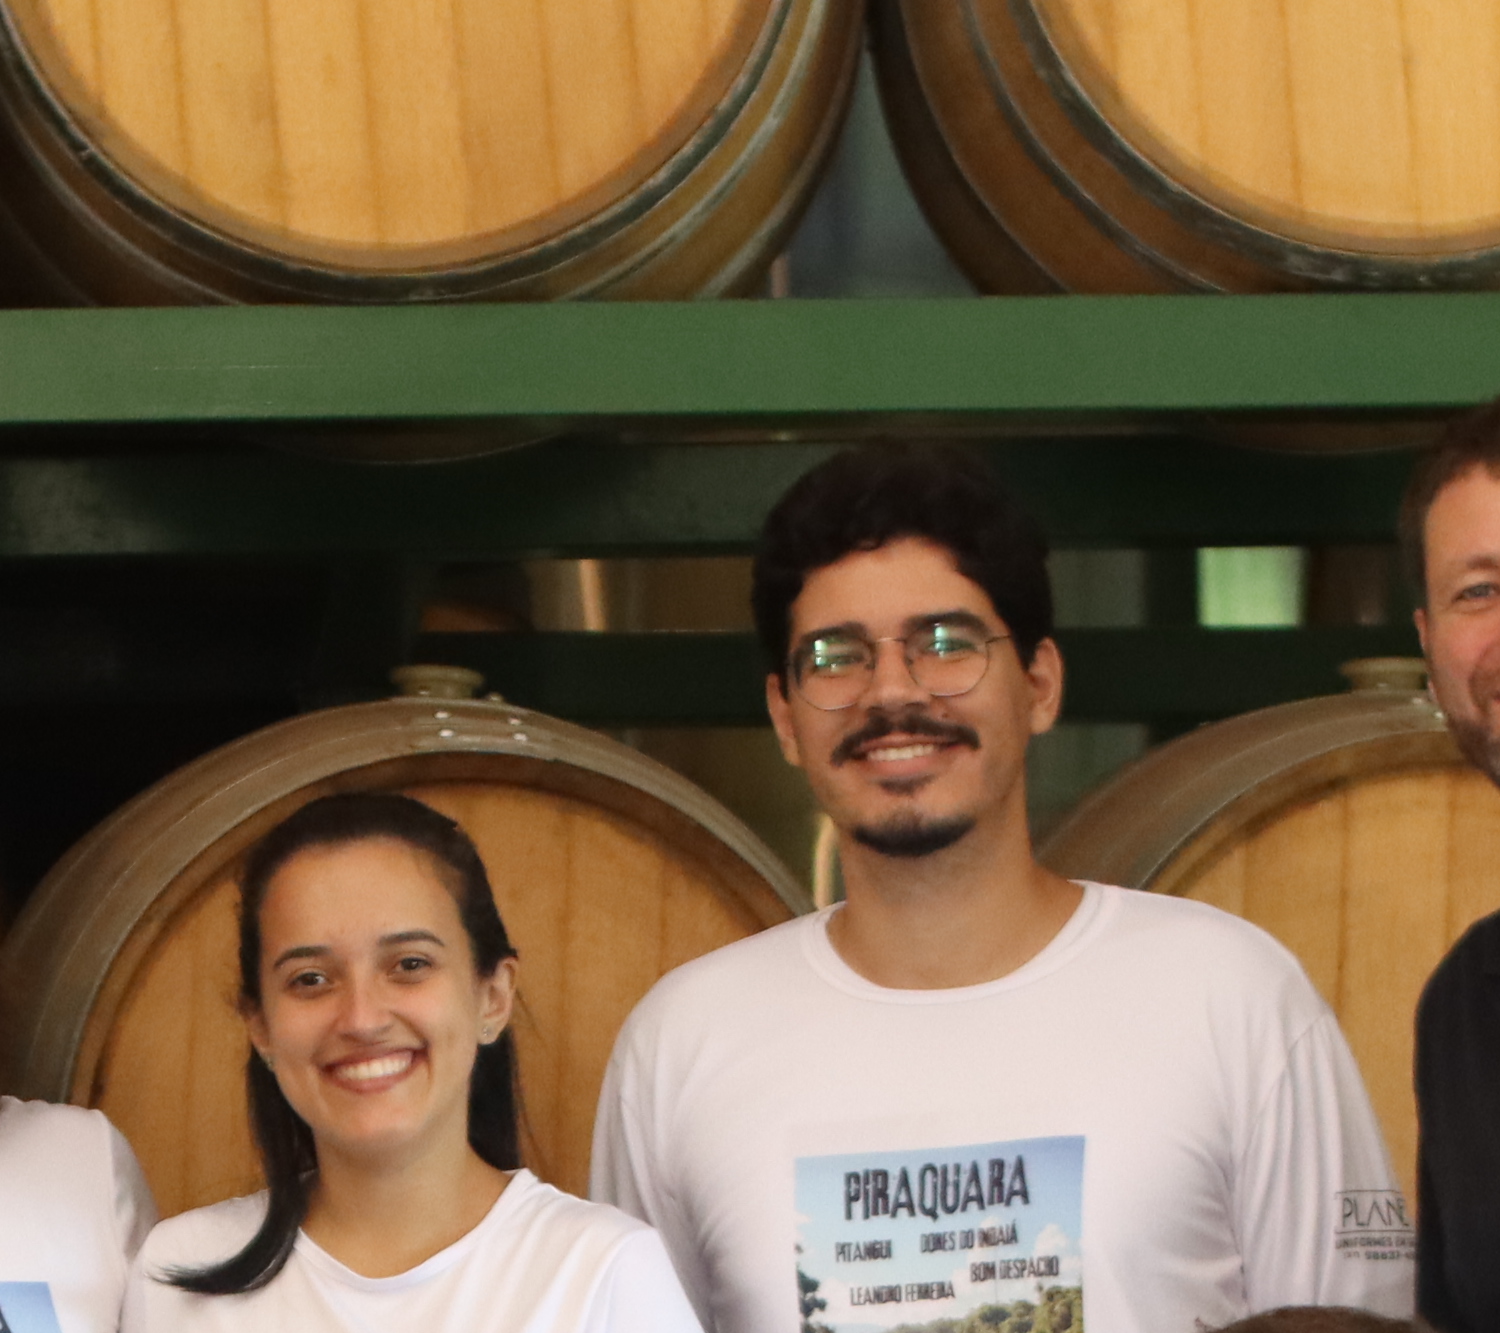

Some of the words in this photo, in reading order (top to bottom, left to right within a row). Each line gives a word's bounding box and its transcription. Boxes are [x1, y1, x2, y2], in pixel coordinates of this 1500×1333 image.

[843, 1154, 1031, 1223] PIRAQUARA
[835, 1239, 893, 1263] PITANGUI
[958, 1228, 975, 1250] DO
[850, 1283, 901, 1306] LEANDRO
[904, 1280, 956, 1301] FERREIRA
[970, 1260, 996, 1283] BOM
[999, 1255, 1060, 1280] DESPACHO
